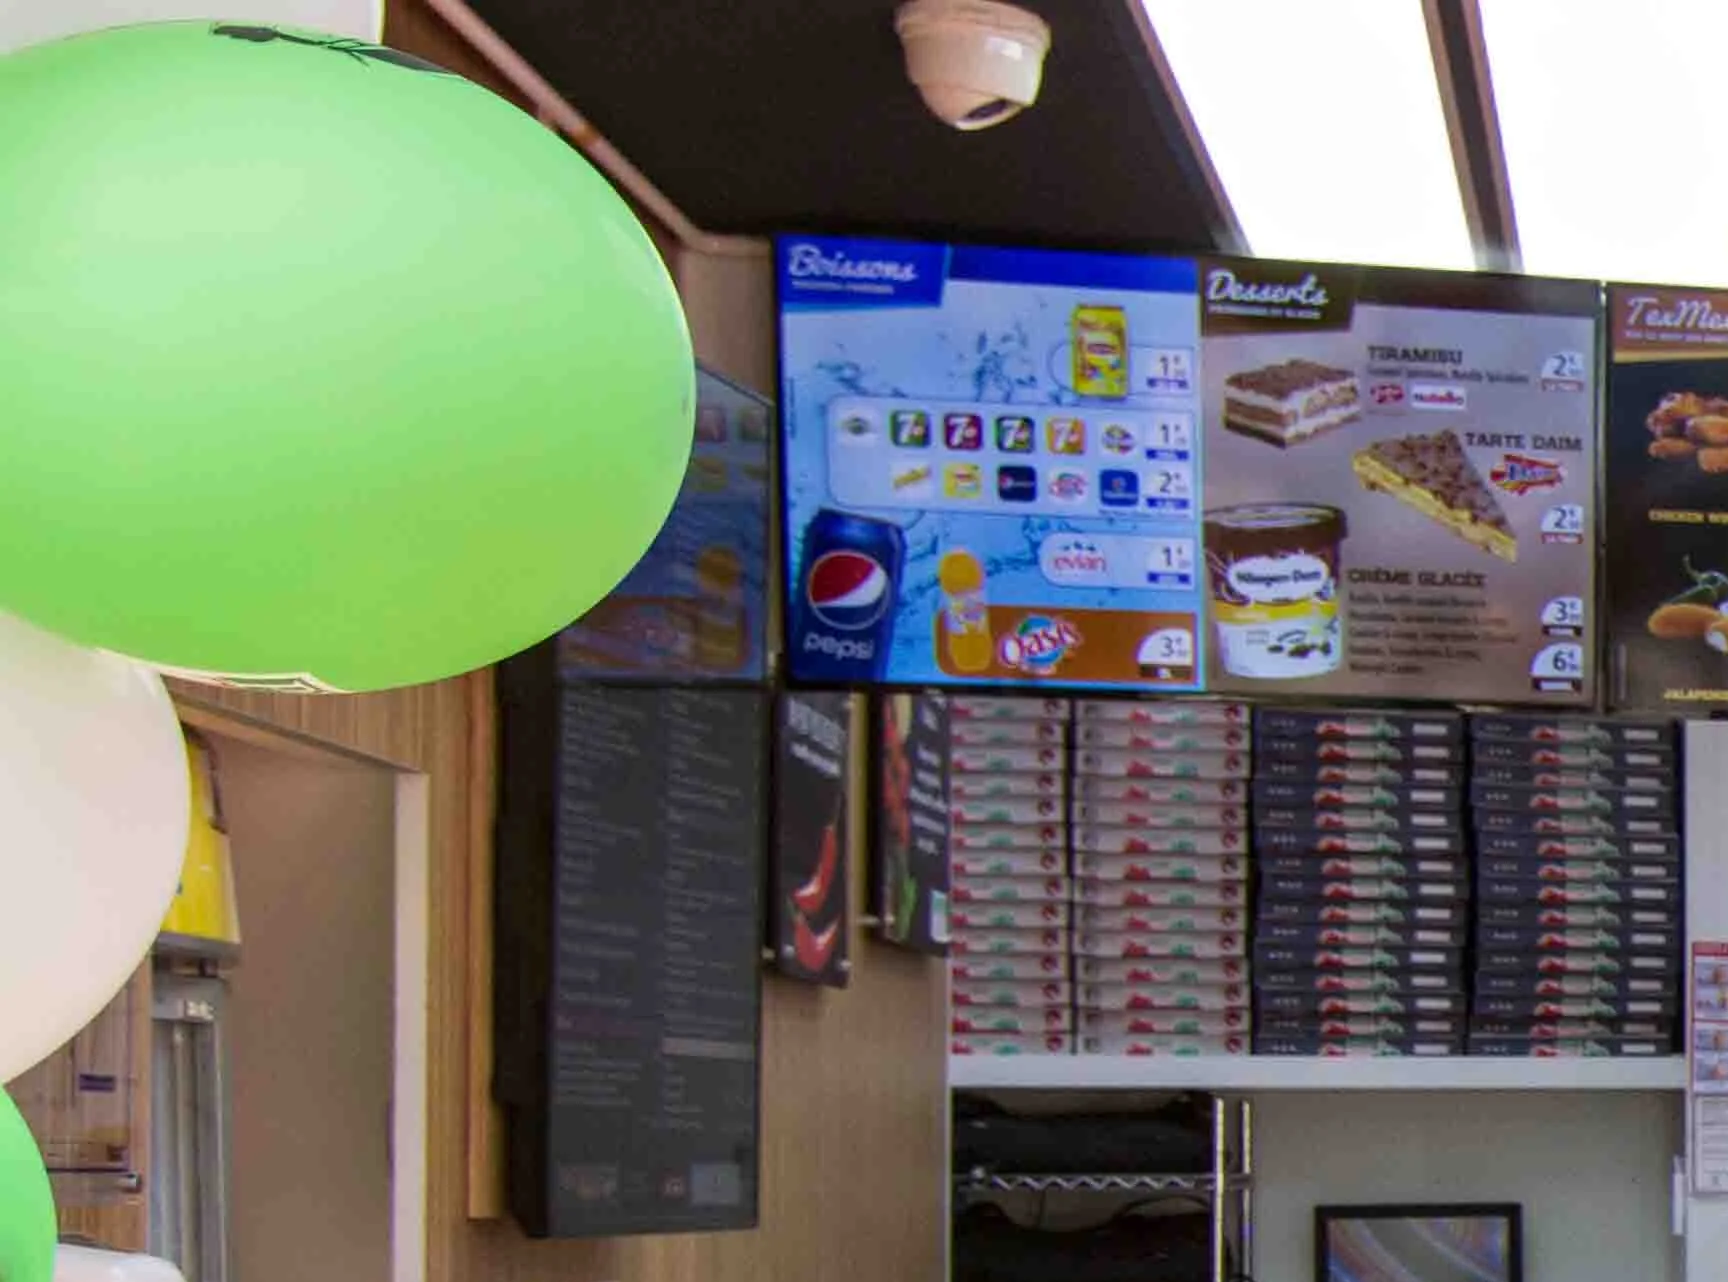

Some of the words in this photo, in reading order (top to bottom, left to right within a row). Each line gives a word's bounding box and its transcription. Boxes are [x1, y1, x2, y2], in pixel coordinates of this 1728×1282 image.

[1207, 269, 1328, 305] Desserts
[1465, 432, 1526, 449] TARTE
[1532, 435, 1583, 452] DAIM
[804, 631, 874, 661] pepsi
